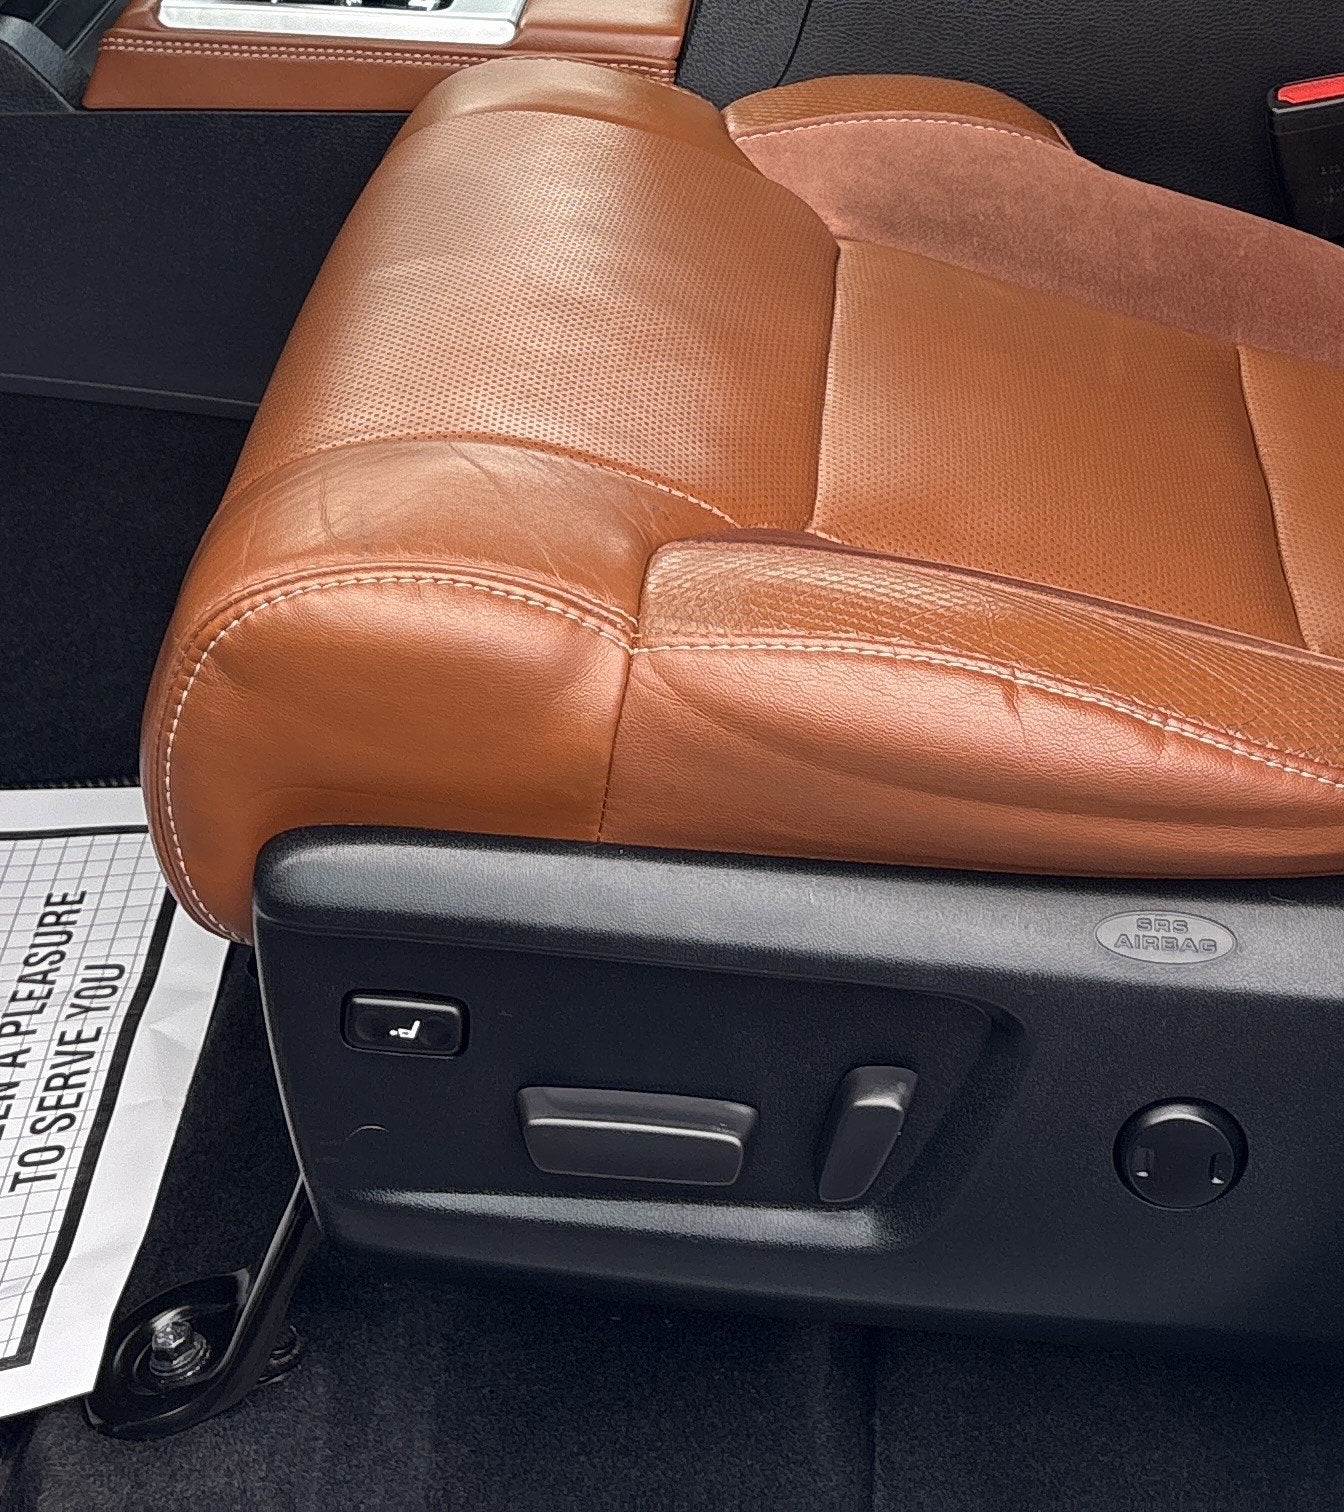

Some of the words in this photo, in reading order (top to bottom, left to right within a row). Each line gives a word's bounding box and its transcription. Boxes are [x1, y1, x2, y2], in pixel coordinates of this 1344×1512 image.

[1114, 934, 1218, 954] AIRBAG
[1136, 917, 1189, 934] SRS
[67, 962, 127, 1020] YOU
[30, 1025, 103, 1135] SERVE
[9, 1143, 66, 1193] TO
